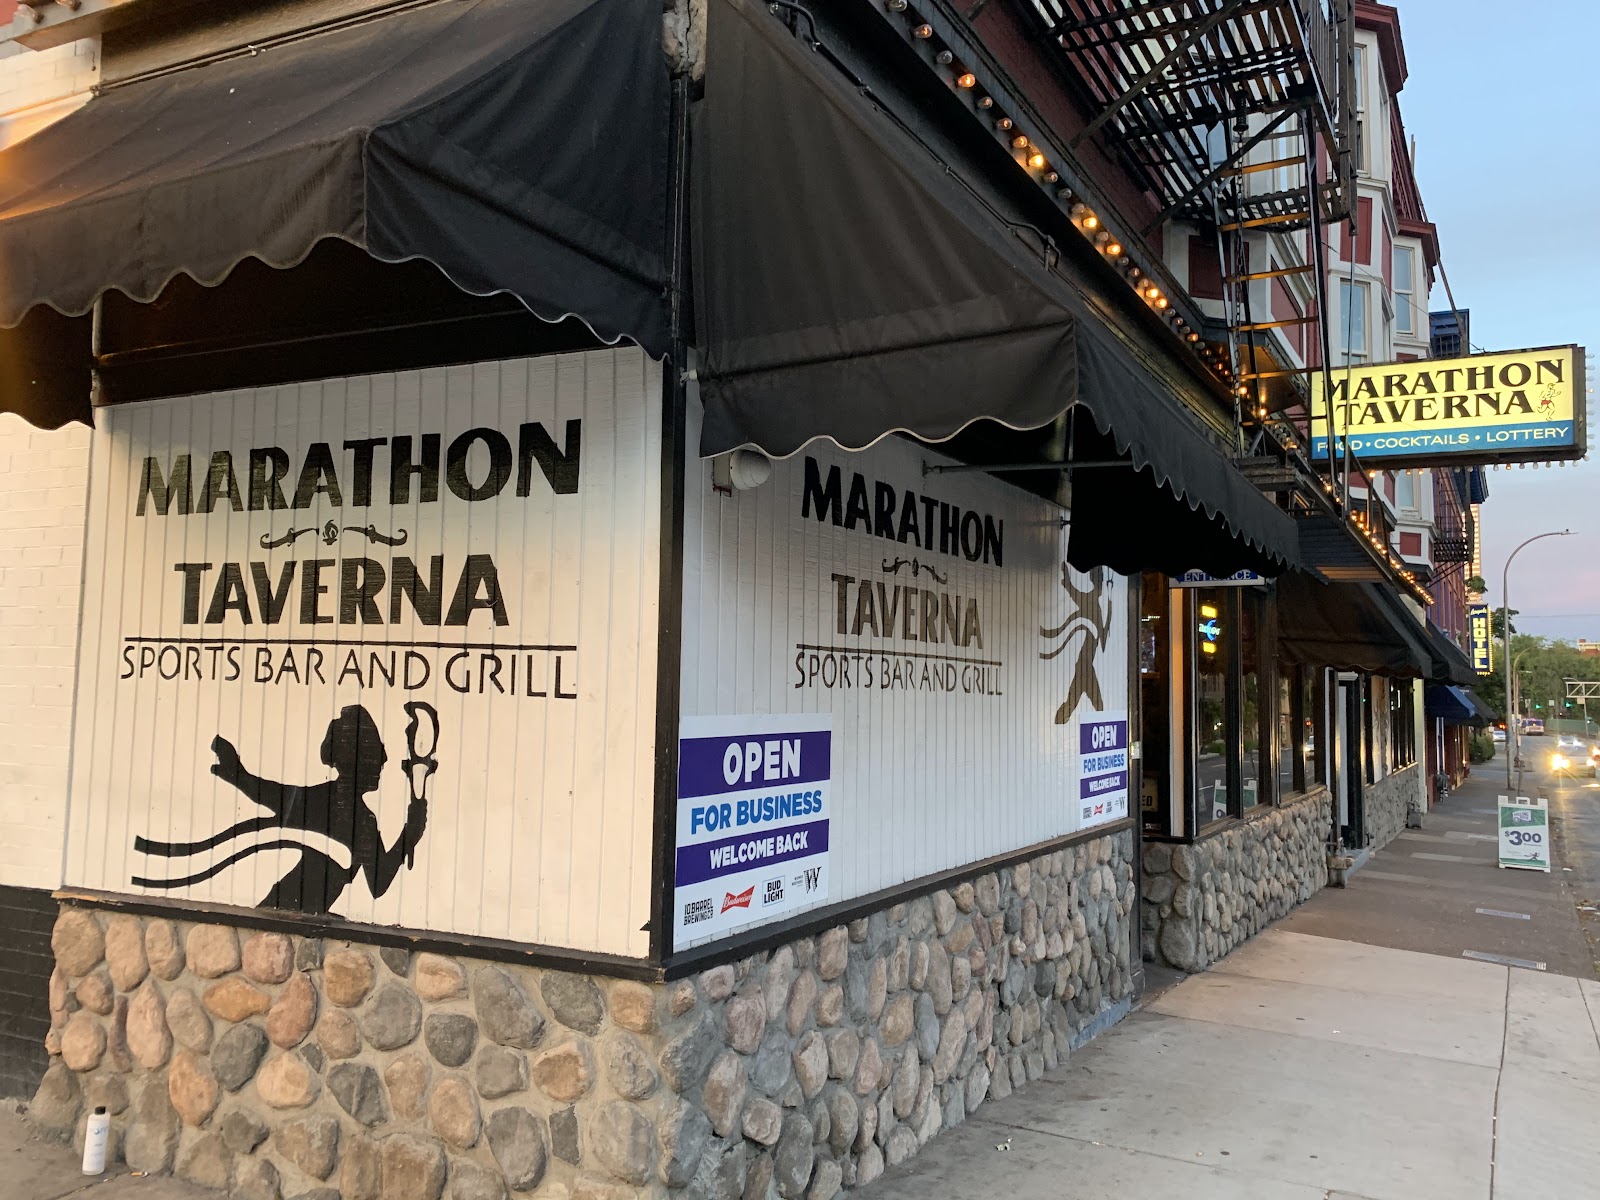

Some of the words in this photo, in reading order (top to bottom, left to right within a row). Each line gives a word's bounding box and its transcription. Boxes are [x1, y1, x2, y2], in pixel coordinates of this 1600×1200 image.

[1321, 358, 1565, 403] MARATHON
[1335, 390, 1535, 426] TAVERNA
[1317, 440, 1363, 452] FD
[1374, 433, 1470, 449] COCKTAILS
[1486, 427, 1569, 443] LOTTERY
[135, 419, 582, 517] MARATHON
[801, 456, 1004, 568] MARATHON
[175, 554, 510, 627] TAVERNA
[1184, 570, 1252, 582] ENTCE
[831, 572, 983, 650] TAVERNA
[1473, 617, 1488, 669] HOTEL
[121, 645, 241, 682] SPORTS
[254, 648, 326, 686] BAR
[338, 649, 431, 690] AND
[445, 651, 577, 699] GRILL
[795, 652, 874, 689] SPORTS
[881, 656, 915, 691] BAR
[920, 660, 957, 692] AND
[961, 664, 1003, 696] GRILL
[1091, 725, 1118, 750] OPEN
[723, 739, 801, 786] OPEN
[1083, 758, 1097, 773] FOR
[1097, 753, 1125, 771] BUSINESS
[1089, 778, 1110, 793] WELCOME
[691, 802, 732, 835] FOR
[736, 790, 823, 827] BUSINESS
[710, 837, 775, 870] WELCOME
[776, 831, 809, 855] BACK
[764, 889, 784, 904] LIGHT
[767, 880, 781, 893] BUD
